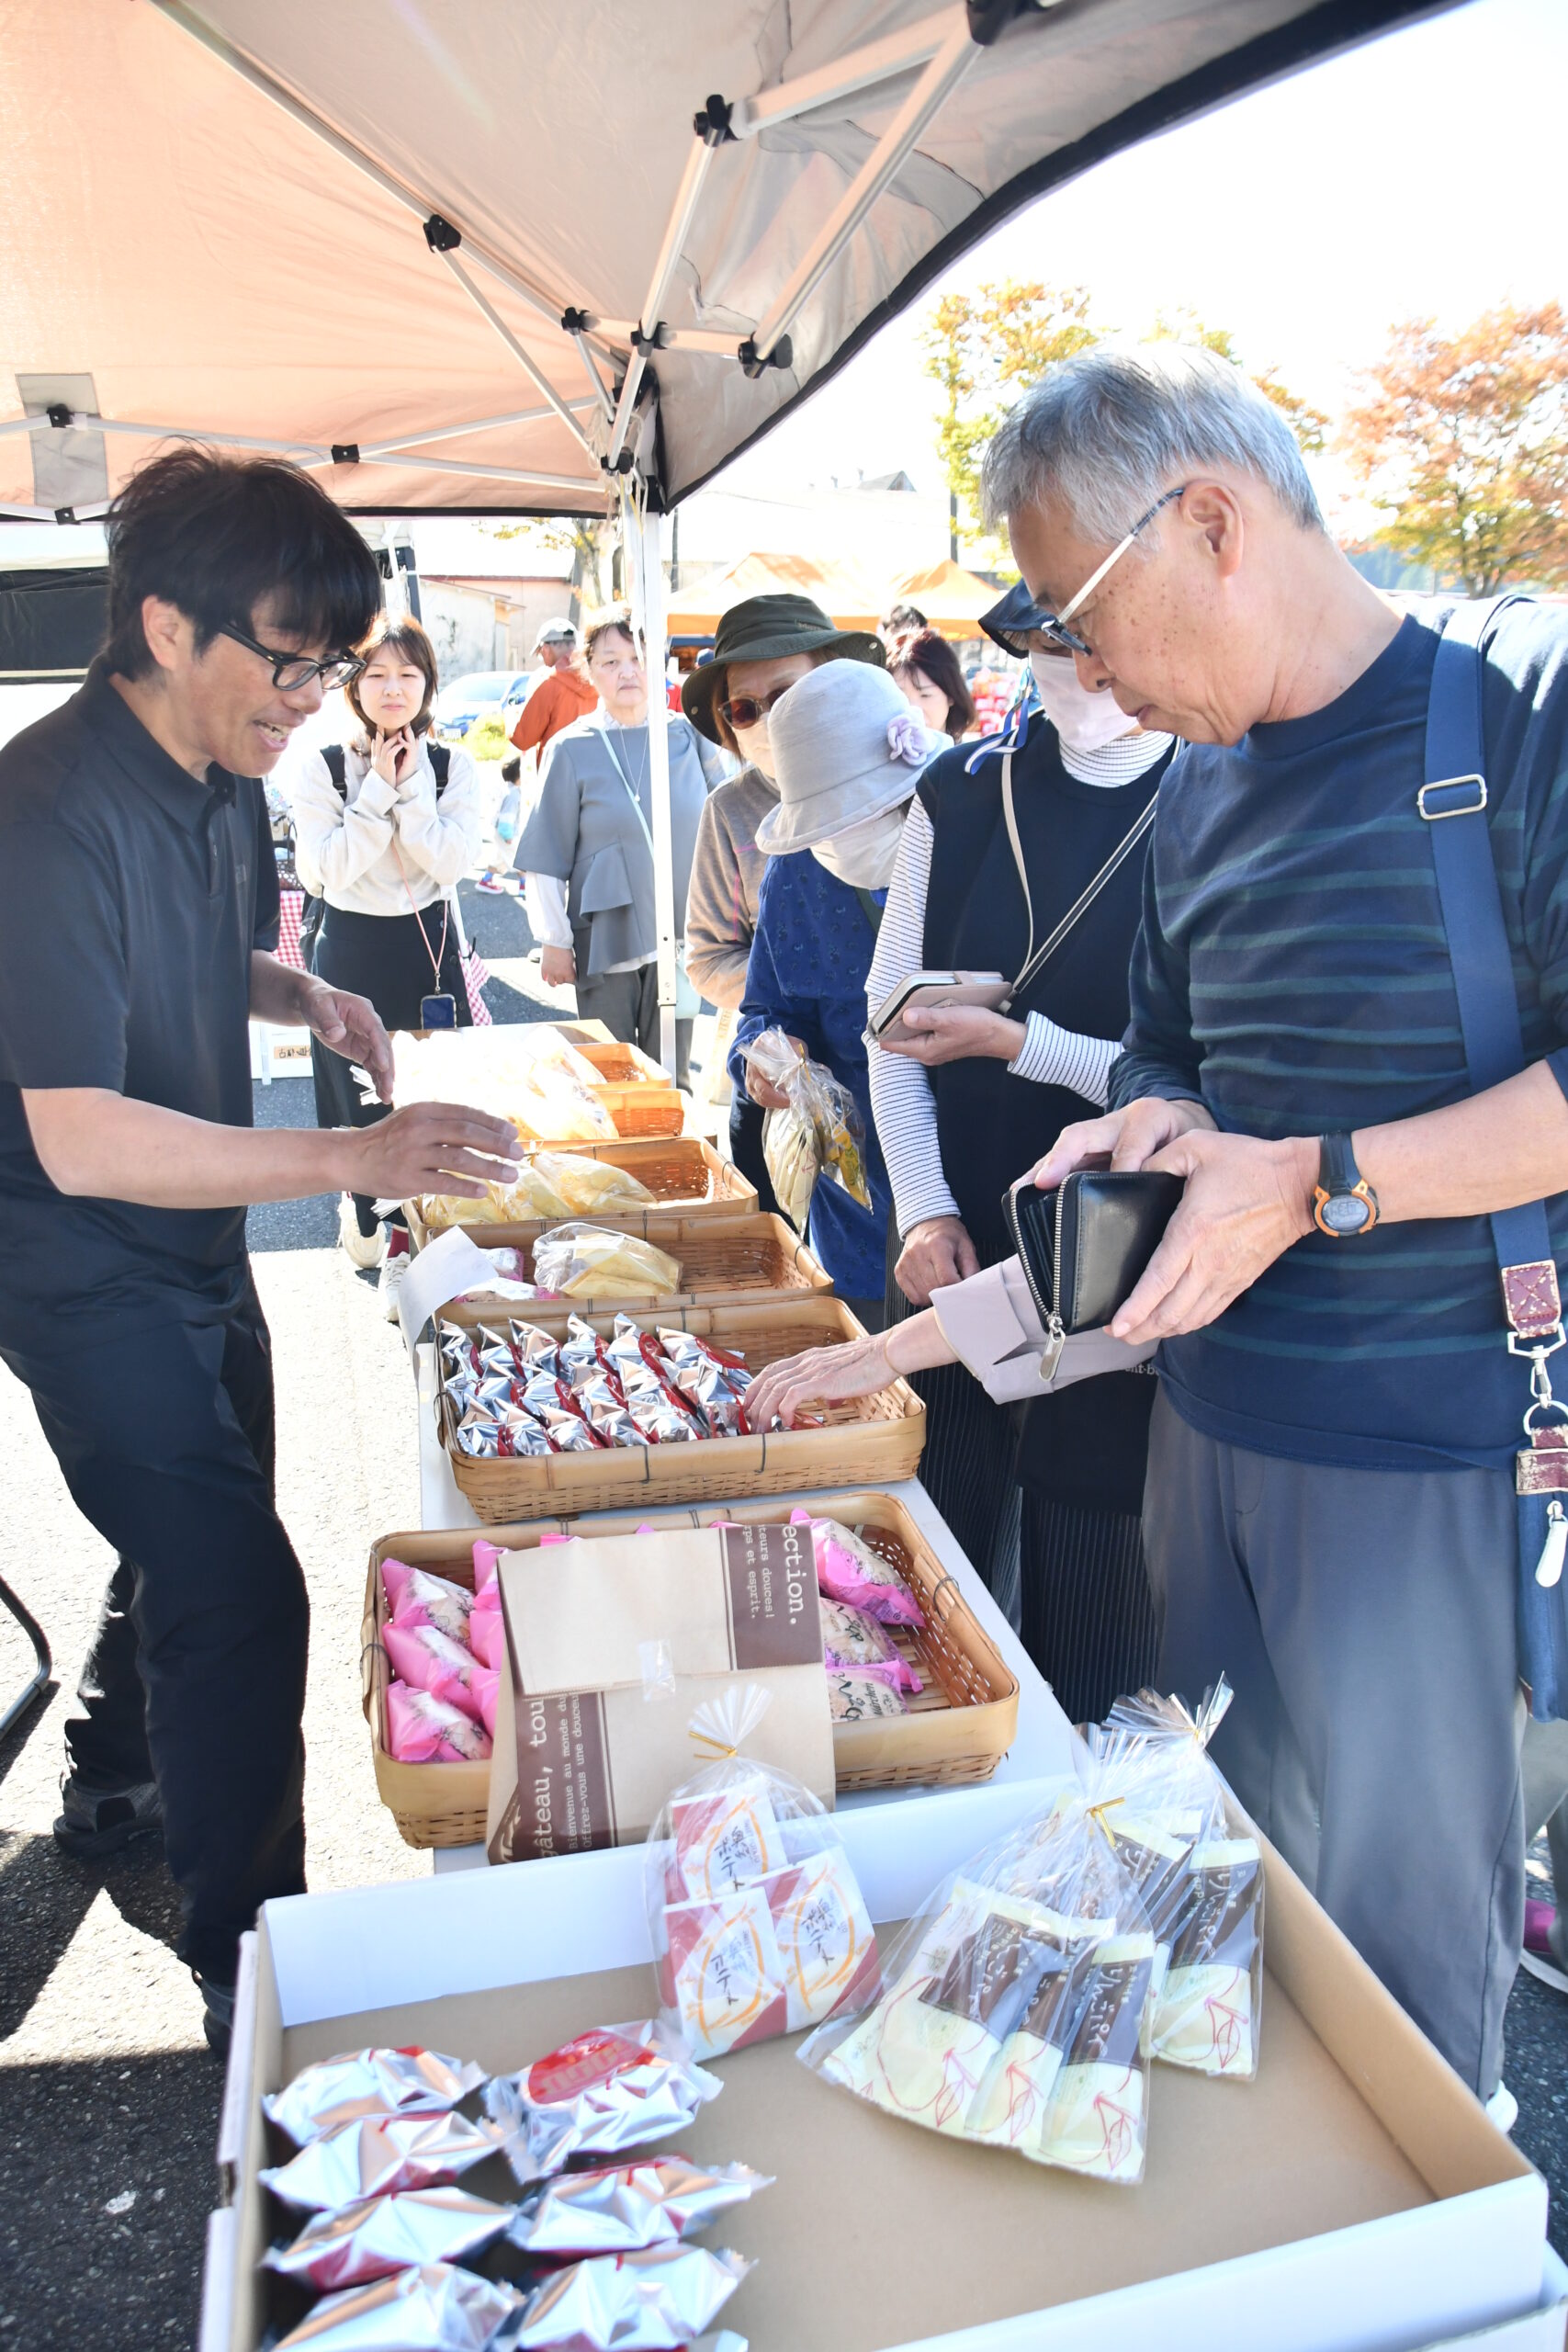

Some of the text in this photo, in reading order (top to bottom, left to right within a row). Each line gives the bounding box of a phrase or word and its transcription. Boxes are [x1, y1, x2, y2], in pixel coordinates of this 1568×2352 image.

[747, 1550, 756, 1564] et
[748, 1571, 761, 1619] esprit.
[762, 1567, 774, 1618] douces!
[558, 1718, 570, 1757] monde
[575, 1743, 584, 1765] une
[563, 1763, 572, 1779] au
[564, 1785, 579, 1849] Bienvenue
[578, 1771, 592, 1849] Offrez-vous
